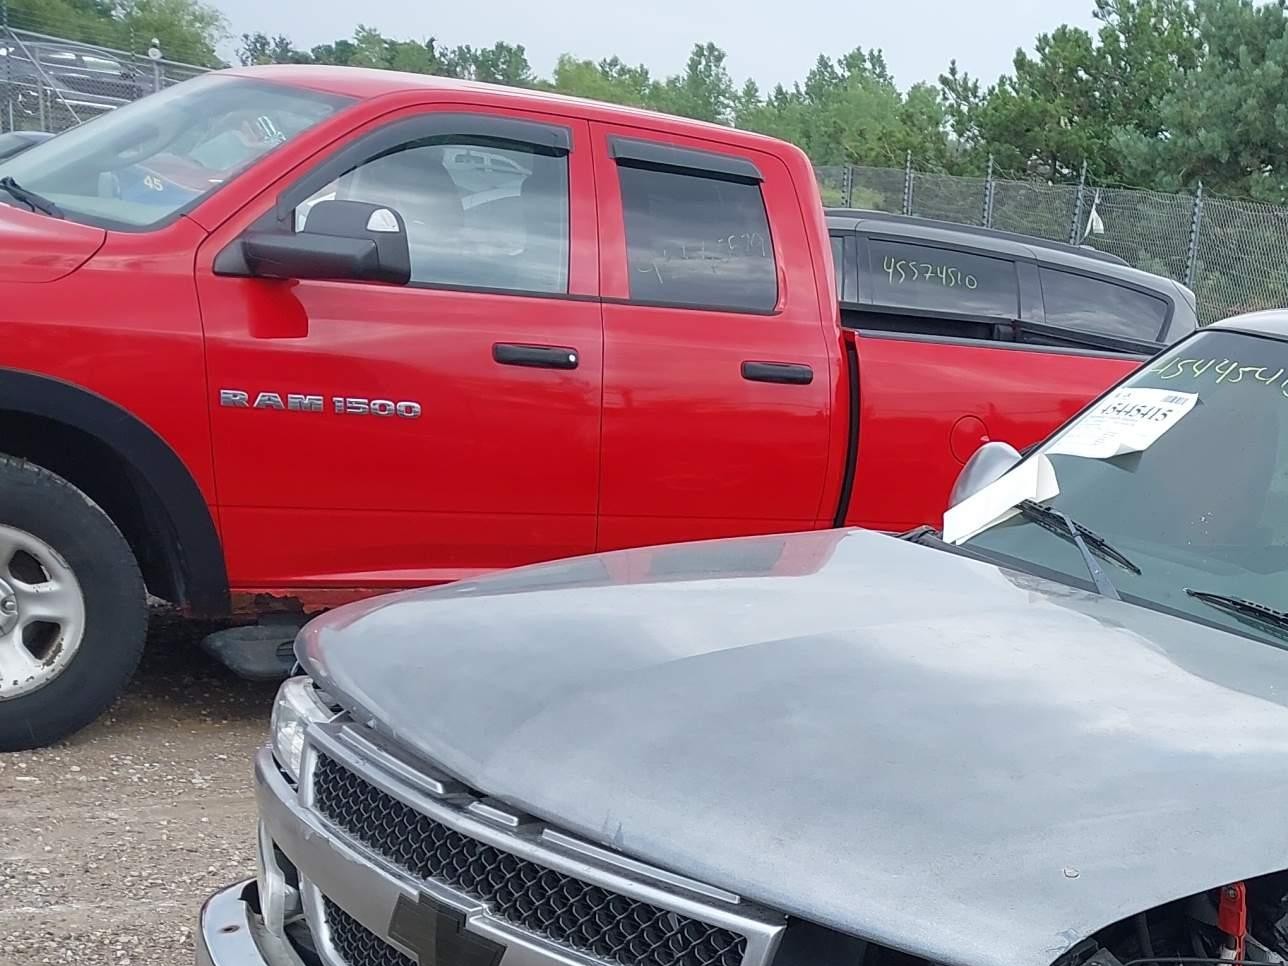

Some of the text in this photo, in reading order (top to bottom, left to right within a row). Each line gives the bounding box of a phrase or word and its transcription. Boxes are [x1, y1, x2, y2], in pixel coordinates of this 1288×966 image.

[883, 256, 978, 289] 45574510
[219, 389, 422, 419] RAM 1500
